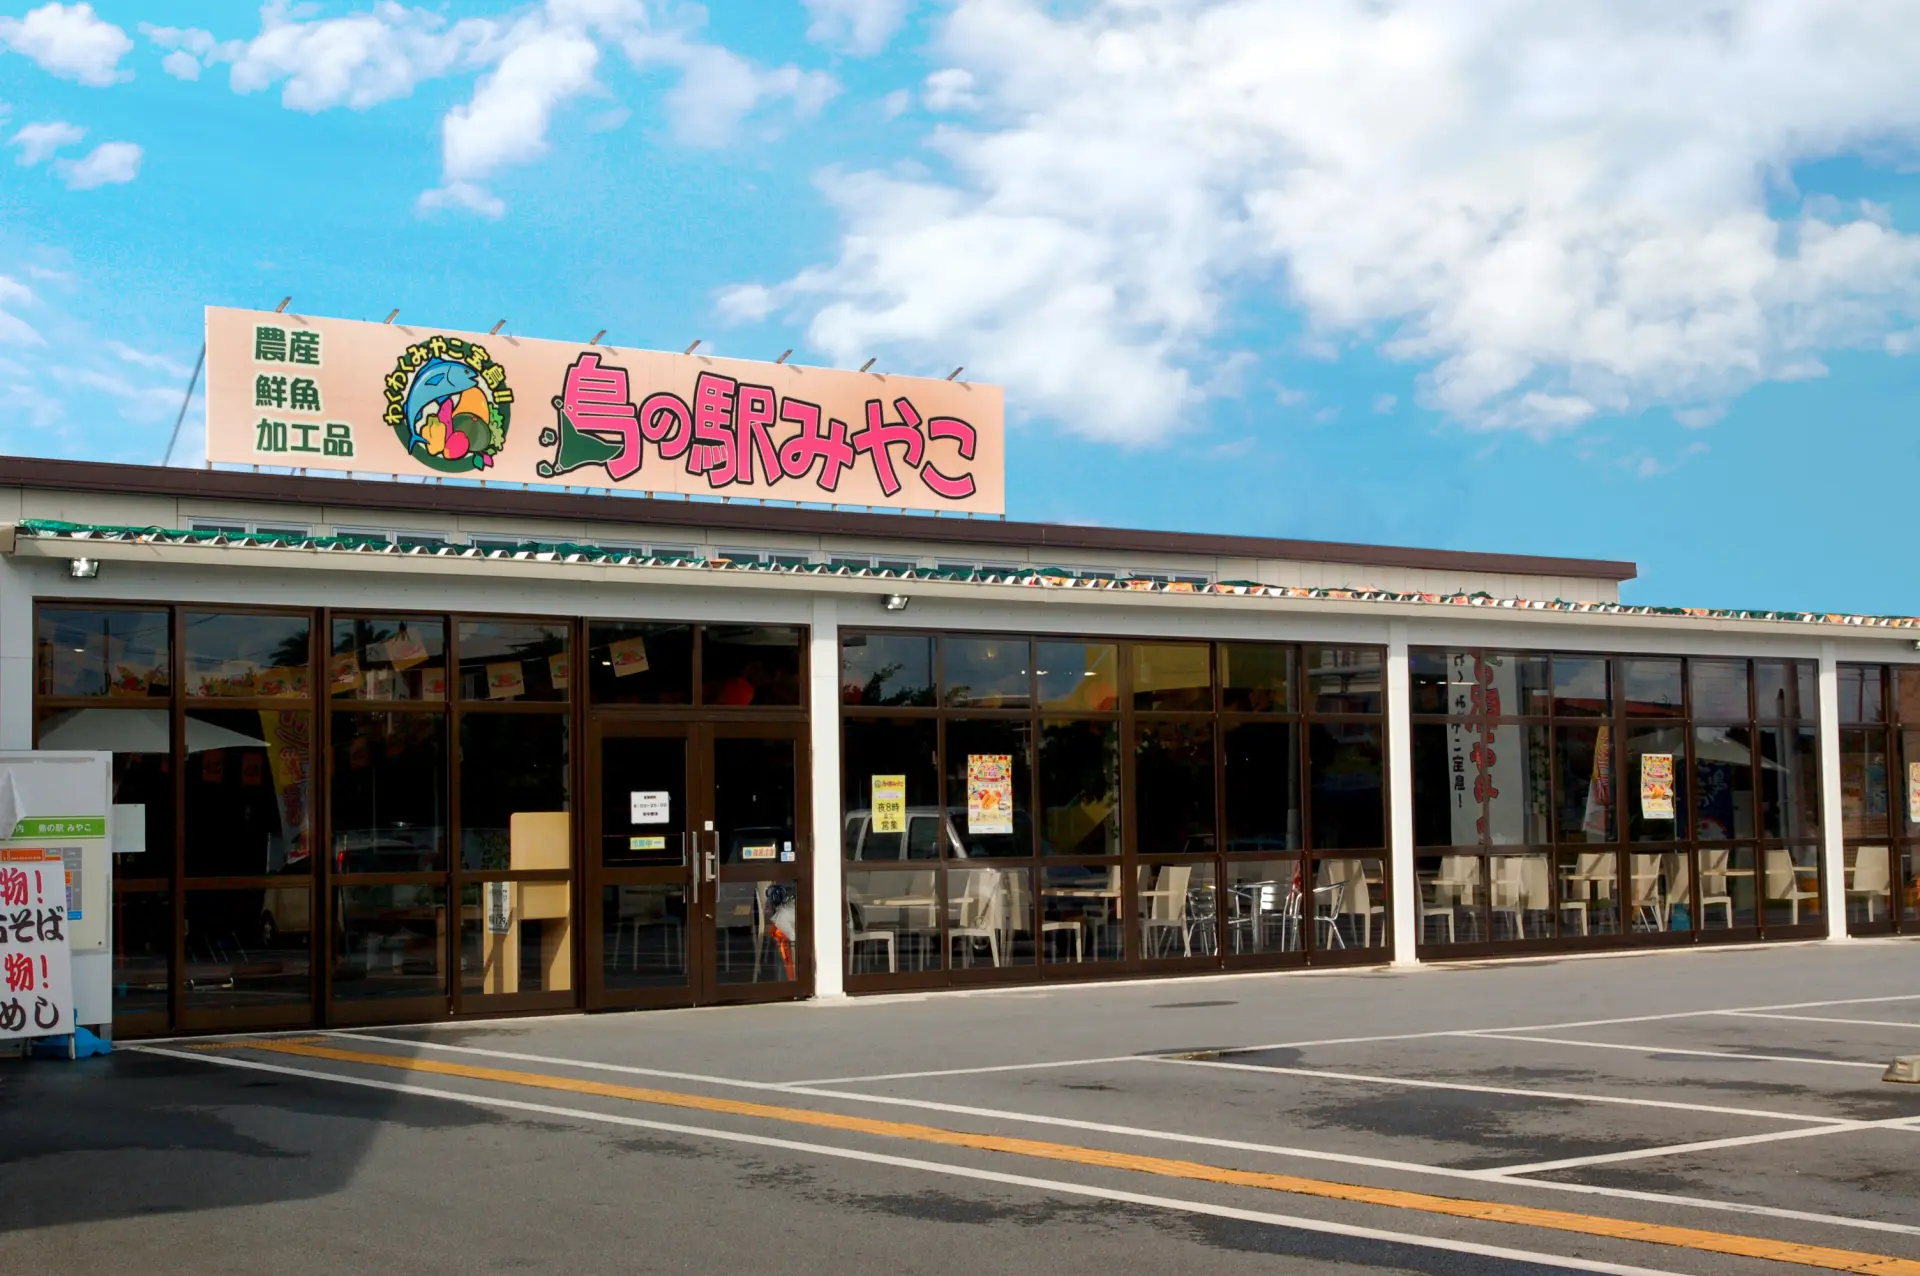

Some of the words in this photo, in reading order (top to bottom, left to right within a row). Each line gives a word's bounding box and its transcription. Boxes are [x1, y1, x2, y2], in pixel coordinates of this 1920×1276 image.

[255, 325, 321, 366] 農産
[255, 374, 321, 411] 鮮魚
[256, 417, 355, 457] 加工品
[553, 352, 977, 498] 島の駅みやこ
[877, 802, 901, 813] 夜8時
[881, 820, 899, 831] 営業
[5, 953, 49, 992] 物!
[0, 995, 59, 1032] めし
